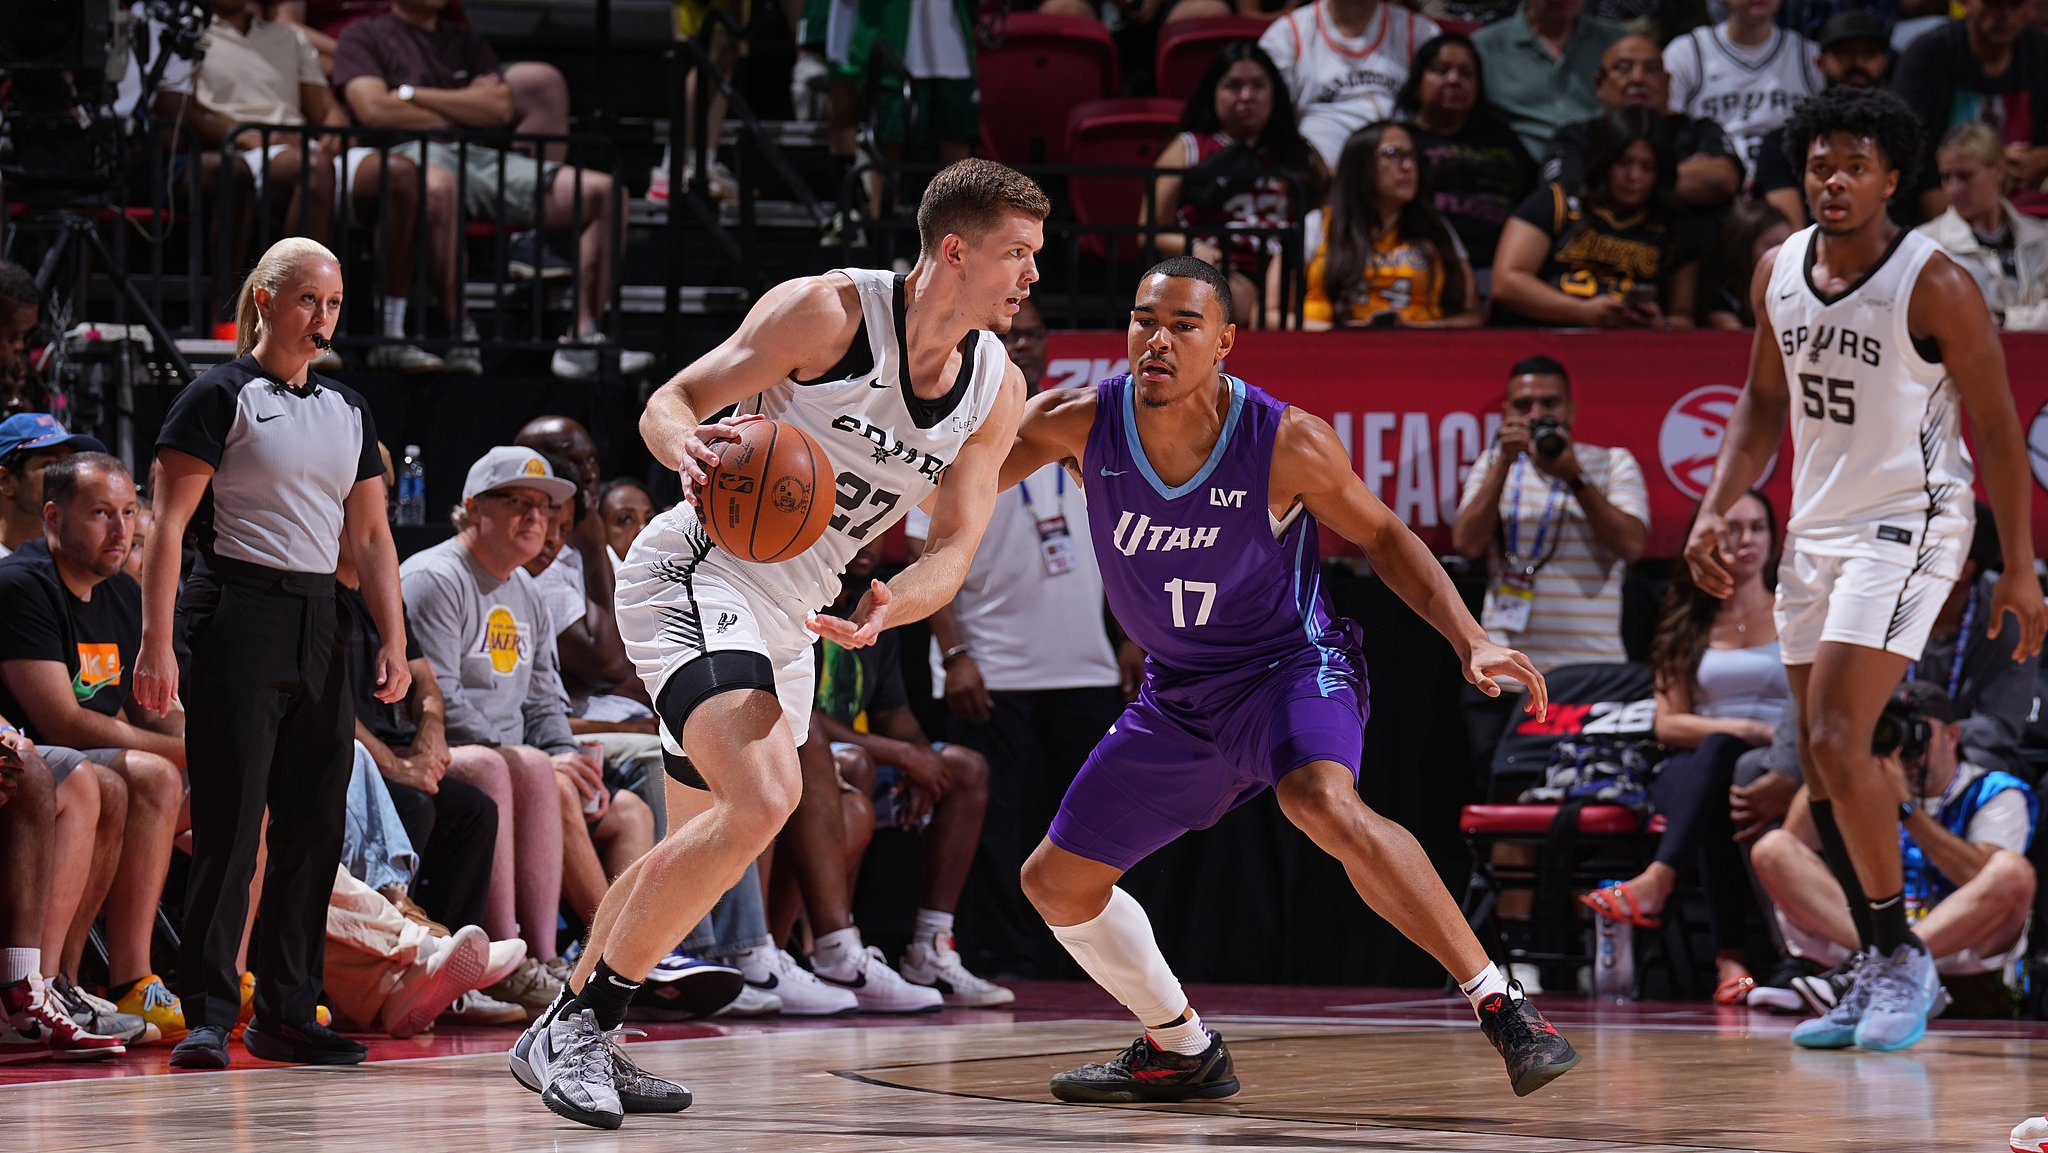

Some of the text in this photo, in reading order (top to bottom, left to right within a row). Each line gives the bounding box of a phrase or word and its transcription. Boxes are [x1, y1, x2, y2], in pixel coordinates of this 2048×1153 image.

[1782, 324, 1881, 367] SPURS
[1798, 373, 1855, 425] 55
[828, 471, 901, 540] 27
[1210, 487, 1248, 508] LVT
[1113, 510, 1221, 556] UTAH
[1164, 577, 1217, 628] 17
[80, 652, 117, 676] IKE
[1516, 698, 1657, 735] 2K26
